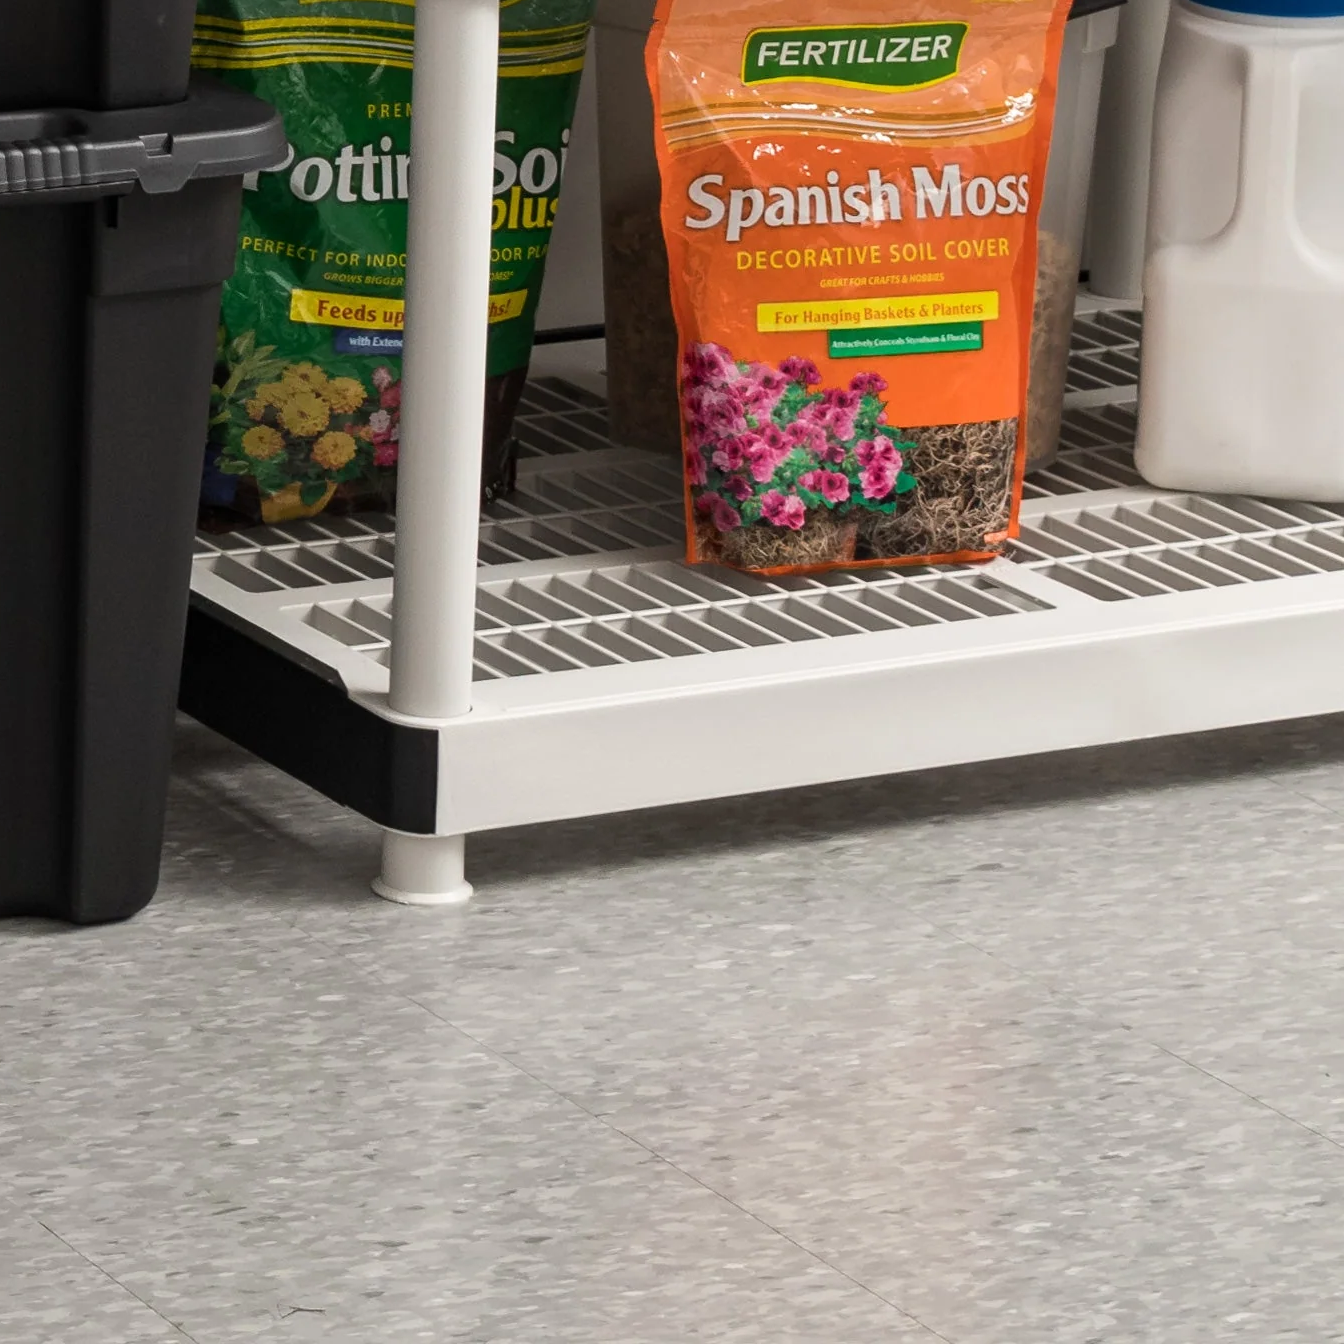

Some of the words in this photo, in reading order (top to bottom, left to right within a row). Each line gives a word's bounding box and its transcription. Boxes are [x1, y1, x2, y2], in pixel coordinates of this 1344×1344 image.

[757, 34, 953, 67] FERTILIZER
[685, 169, 903, 242] Spanish
[912, 164, 1029, 219] Moss
[241, 236, 318, 261] PERFECT
[325, 252, 360, 267] FOR
[736, 245, 882, 270] DECORATIVE
[889, 242, 936, 263] SOIL
[944, 237, 1010, 260] COVER
[324, 272, 362, 284] GROWS
[364, 276, 404, 286] BIGGER
[820, 278, 848, 288] GREAT
[849, 277, 867, 287] FOR
[868, 275, 900, 285] CRAFTS
[909, 272, 945, 283] HOBBIES
[317, 299, 376, 322] Feeds
[382, 310, 405, 327] up
[774, 311, 799, 325] For
[803, 308, 861, 325] Hanging
[864, 304, 915, 320] Baskets
[918, 304, 929, 317] &
[932, 302, 984, 317] Planters
[349, 336, 371, 346] with
